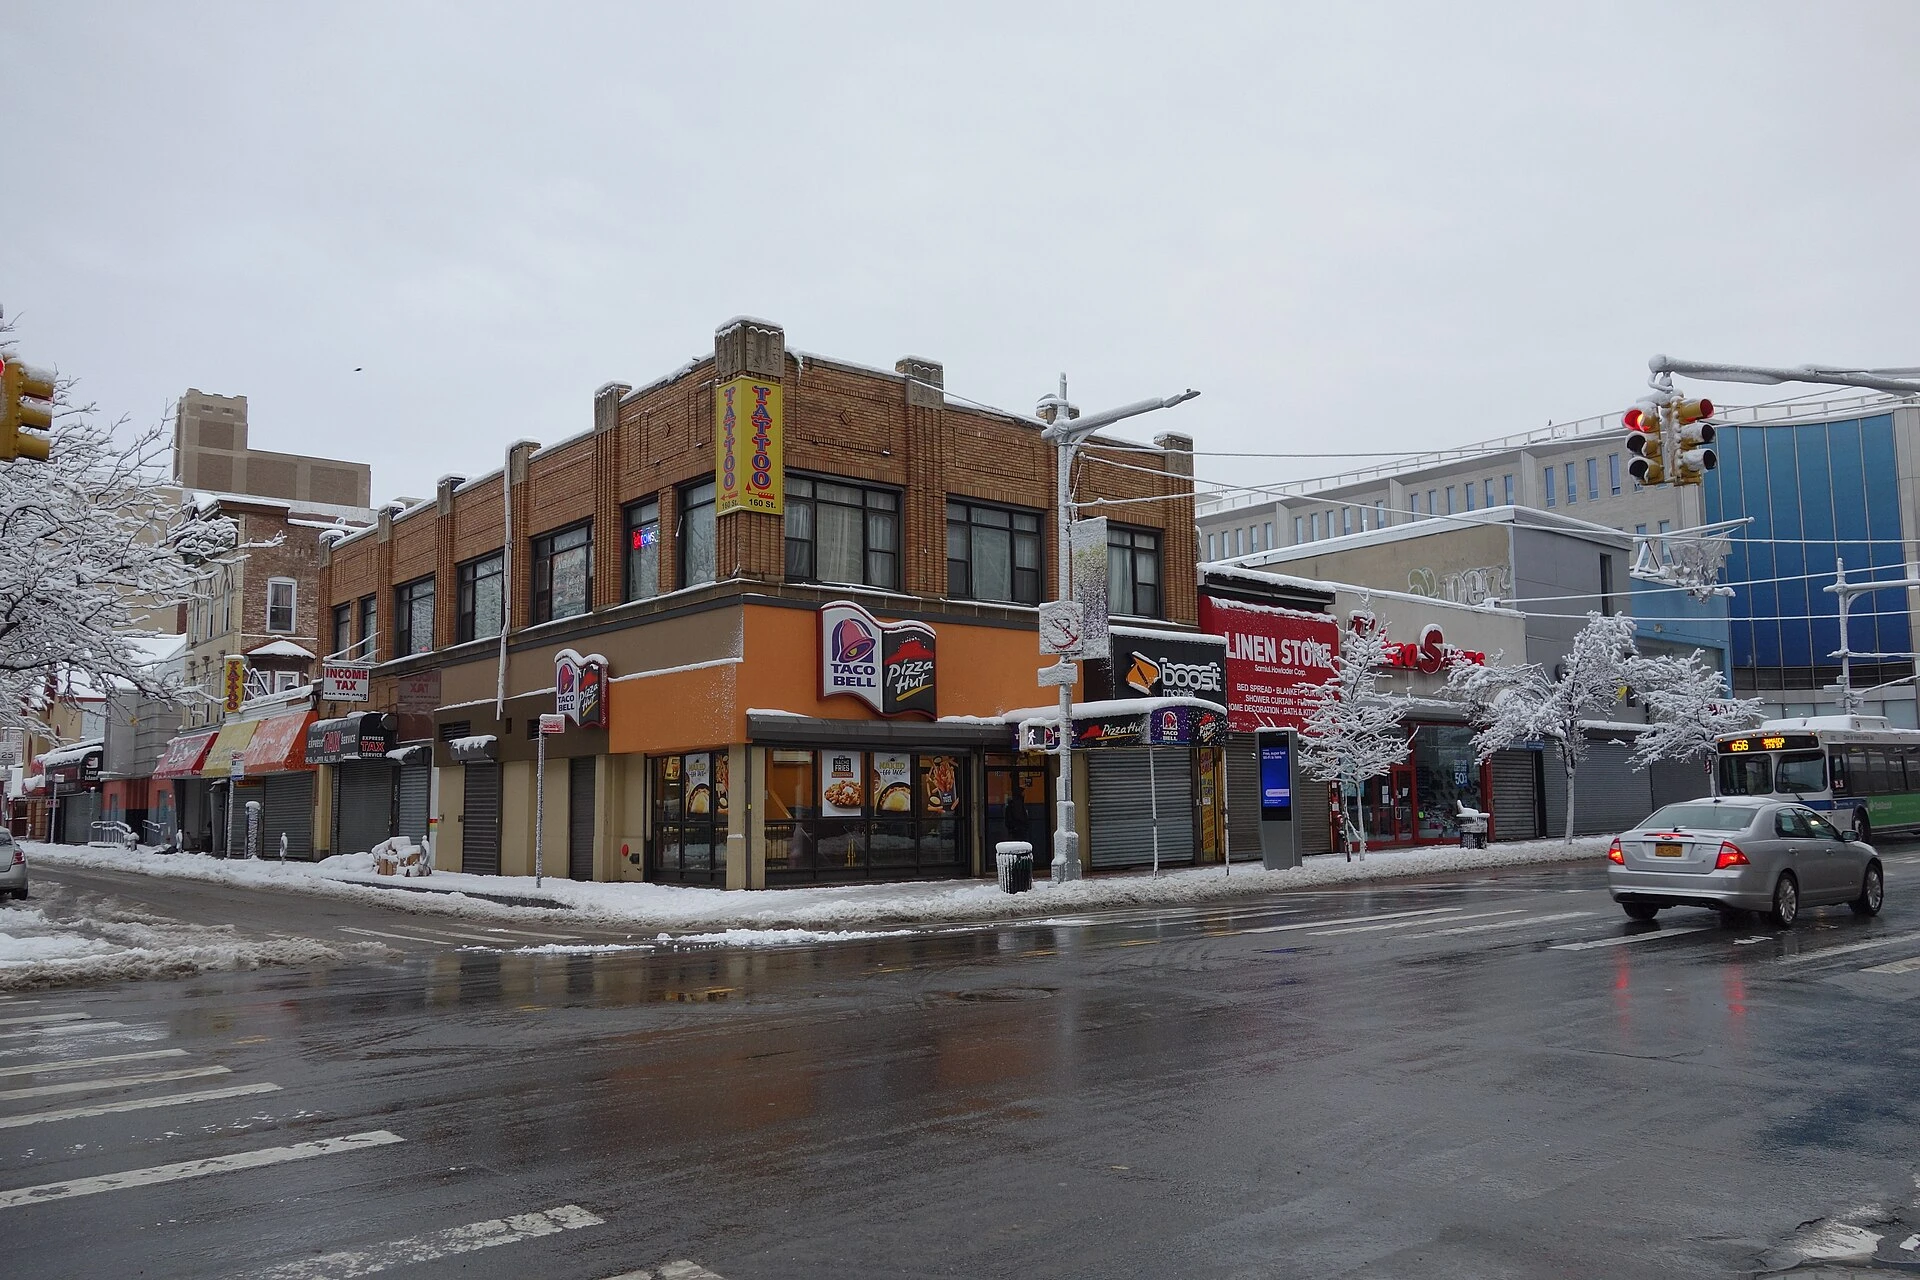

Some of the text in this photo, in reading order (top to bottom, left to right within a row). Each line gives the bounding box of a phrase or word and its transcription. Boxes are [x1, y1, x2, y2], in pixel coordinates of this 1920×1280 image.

[723, 386, 737, 492] TATTOO
[751, 385, 772, 490] TATTOO
[749, 498, 777, 509] 160 St.
[1224, 631, 1332, 669] LINEN STORE
[325, 667, 368, 680] INCOME
[830, 663, 876, 675] TACO
[886, 658, 934, 688] Pizza
[1162, 658, 1222, 692] boost
[227, 660, 240, 711] TATTOO
[335, 680, 357, 691] TAX
[833, 676, 877, 688] BELL
[895, 674, 930, 695] Hut
[579, 683, 599, 700] Pizza
[1236, 683, 1249, 692] BED
[1249, 683, 1273, 694] SPREAD
[1275, 685, 1301, 696] BLANKET
[557, 695, 575, 703] TACO
[582, 693, 596, 711] Hut
[1245, 694, 1270, 704] SHOWER
[1270, 696, 1294, 706] CURTAIN
[558, 703, 575, 711] BELL
[1244, 704, 1280, 714] DECORATION
[1283, 706, 1298, 715] BATH
[1101, 723, 1127, 737] Pizza
[361, 741, 385, 752] TAX
[1731, 739, 1749, 751] Q56
[1, 751, 14, 759] 25
[834, 764, 850, 772] FRIES
